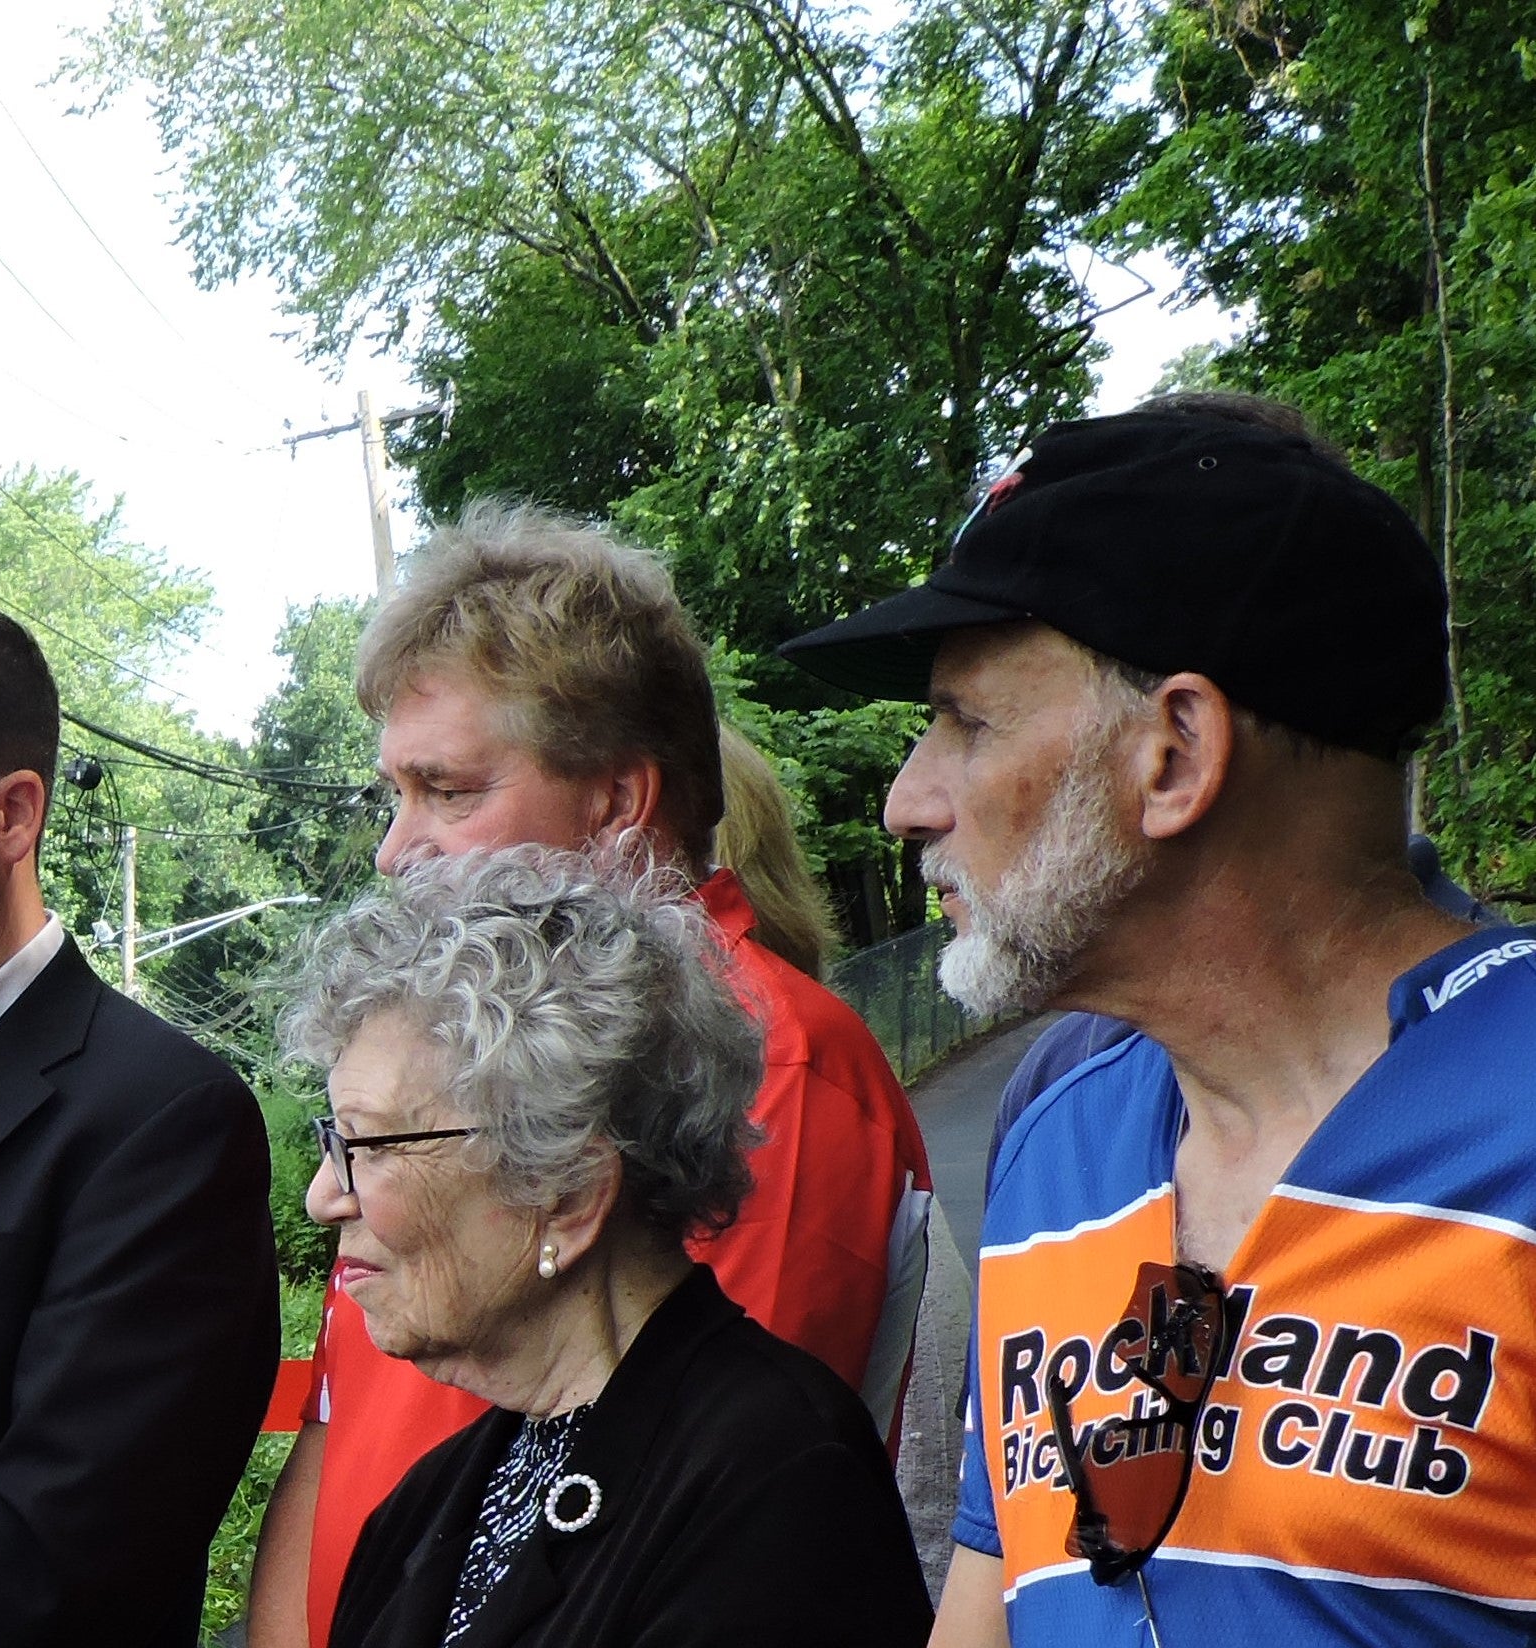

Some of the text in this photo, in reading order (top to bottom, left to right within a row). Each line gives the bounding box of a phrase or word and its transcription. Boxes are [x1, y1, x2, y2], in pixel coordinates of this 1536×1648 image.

[1422, 940, 1536, 1013] VERG
[1000, 1284, 1499, 1432] Rockland
[1259, 1398, 1472, 1498] Club
